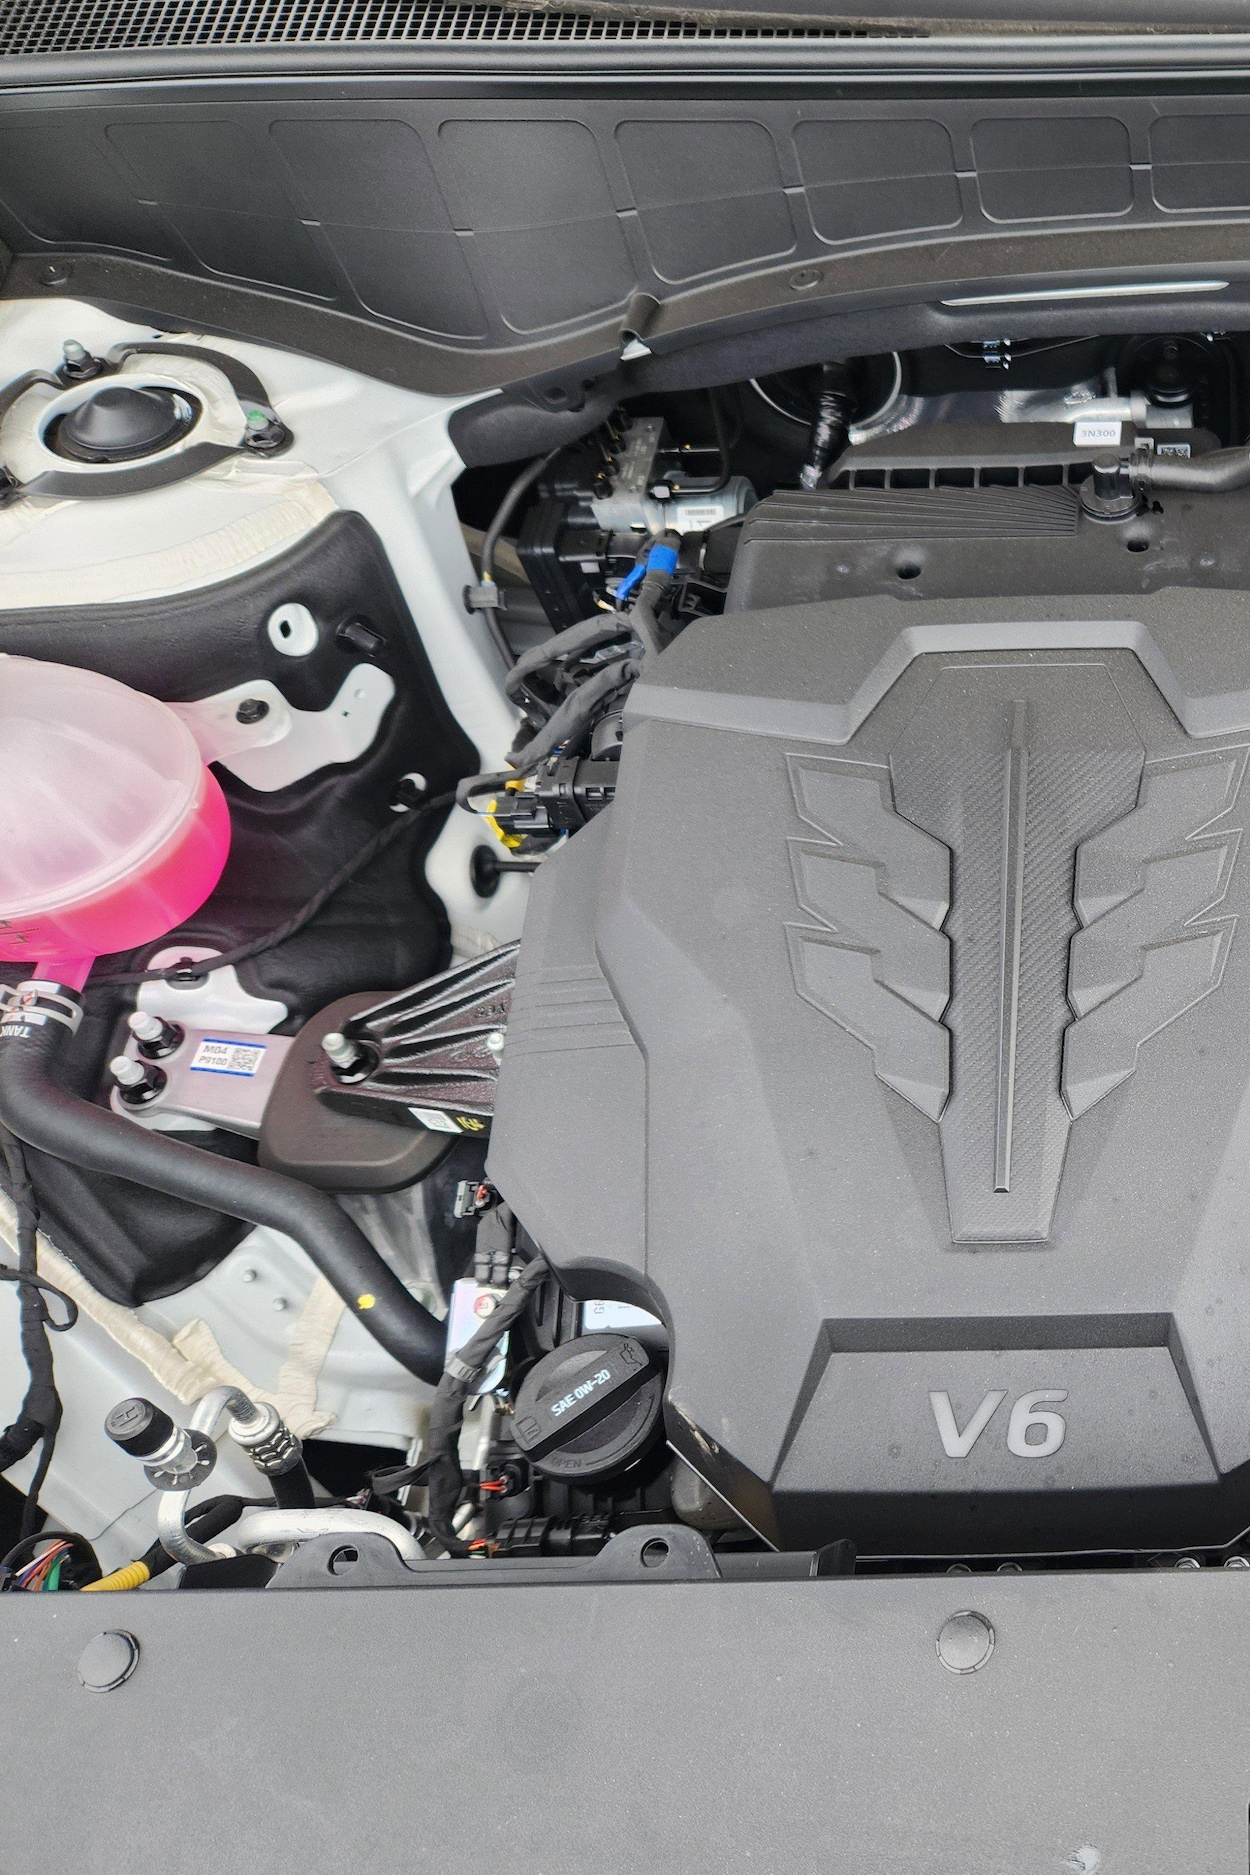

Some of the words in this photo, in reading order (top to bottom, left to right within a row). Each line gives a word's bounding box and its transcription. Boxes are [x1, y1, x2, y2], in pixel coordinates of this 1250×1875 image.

[1081, 429, 1116, 438] 3N300
[0, 1025, 30, 1039] TANK
[198, 1056, 228, 1066] P9100
[551, 1393, 577, 1417] SAE
[574, 1368, 612, 1400] 0W-20
[928, 1388, 1069, 1459] V6
[552, 1457, 583, 1469] OPEN
